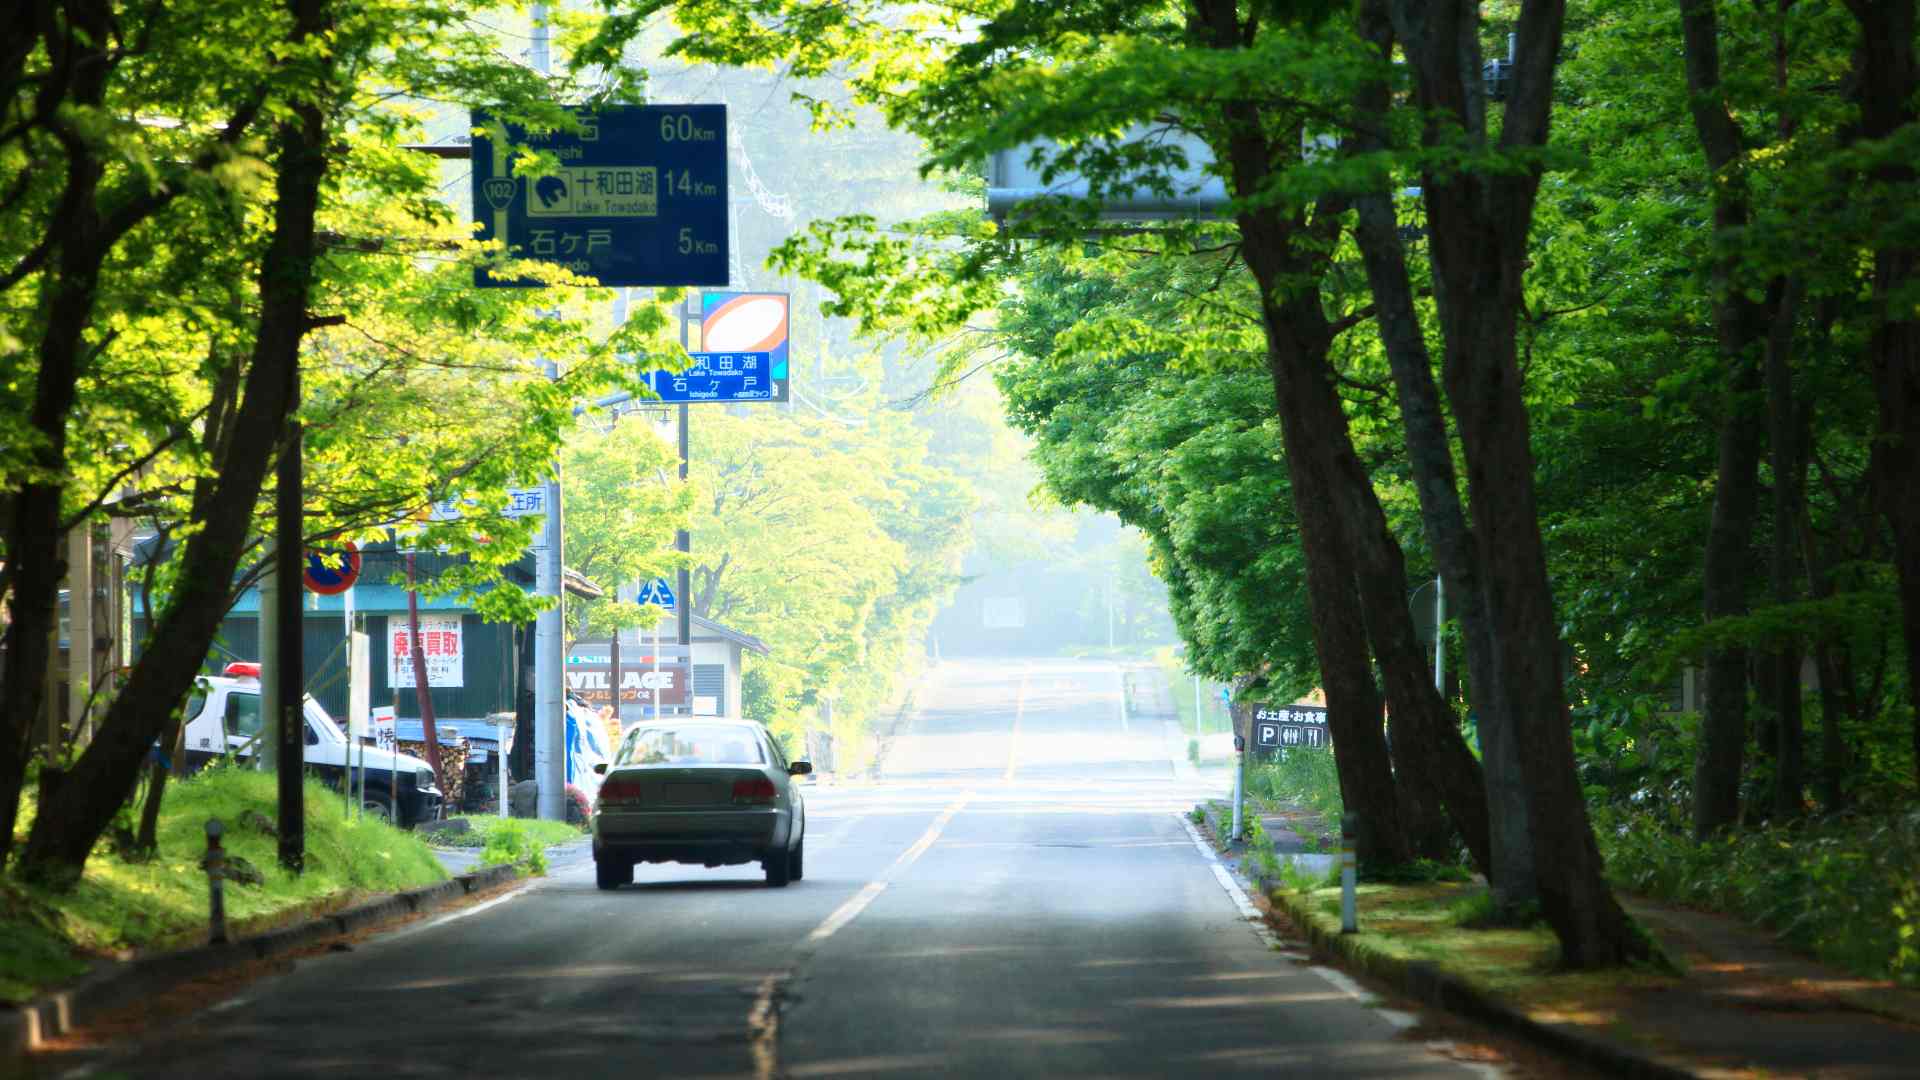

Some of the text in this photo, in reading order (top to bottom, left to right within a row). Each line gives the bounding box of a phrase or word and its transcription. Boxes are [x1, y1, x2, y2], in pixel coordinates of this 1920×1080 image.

[489, 183, 513, 198] 102
[576, 170, 654, 196] 十和田湖
[694, 355, 758, 370] 和田湖
[567, 671, 674, 689] VILAGE
[1263, 726, 1275, 742] P
